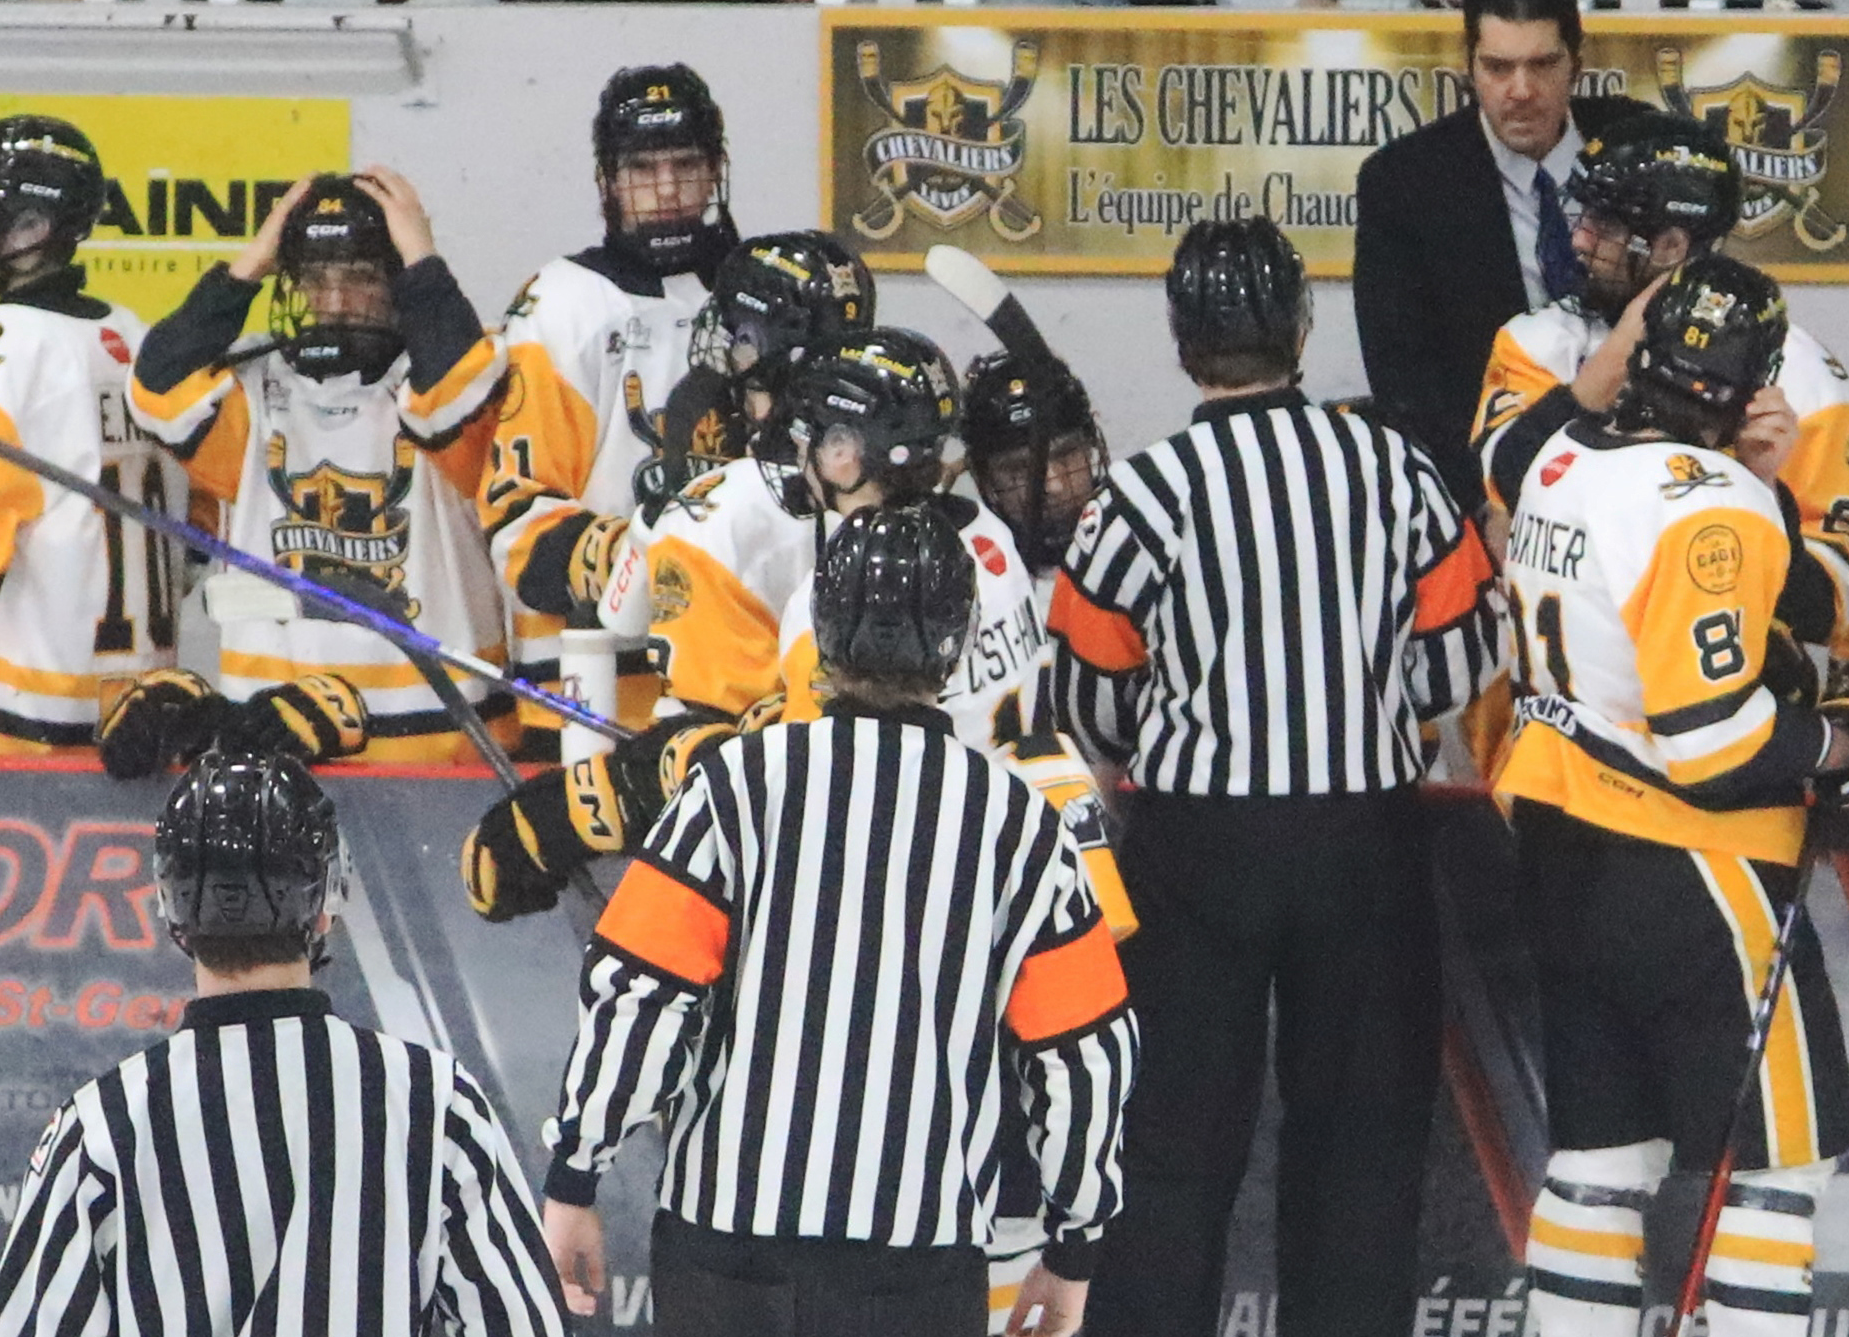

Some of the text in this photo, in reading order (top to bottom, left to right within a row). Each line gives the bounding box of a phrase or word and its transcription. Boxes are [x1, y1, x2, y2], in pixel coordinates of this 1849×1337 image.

[645, 85, 671, 103] 21
[1067, 64, 1145, 145] LES
[1156, 64, 1435, 147] CHEVALIERS
[638, 110, 683, 124] CCM
[876, 134, 1013, 171] CHEVALIERS
[1736, 146, 1817, 180] ALIERS
[1067, 169, 1203, 236] L'équipe
[1212, 170, 1251, 224] de
[306, 223, 349, 239] CCM
[1683, 324, 1710, 349] 81
[826, 394, 867, 414] CCM
[609, 548, 639, 613] CCM
[1692, 609, 1747, 682] 8
[1597, 771, 1645, 799] CCM
